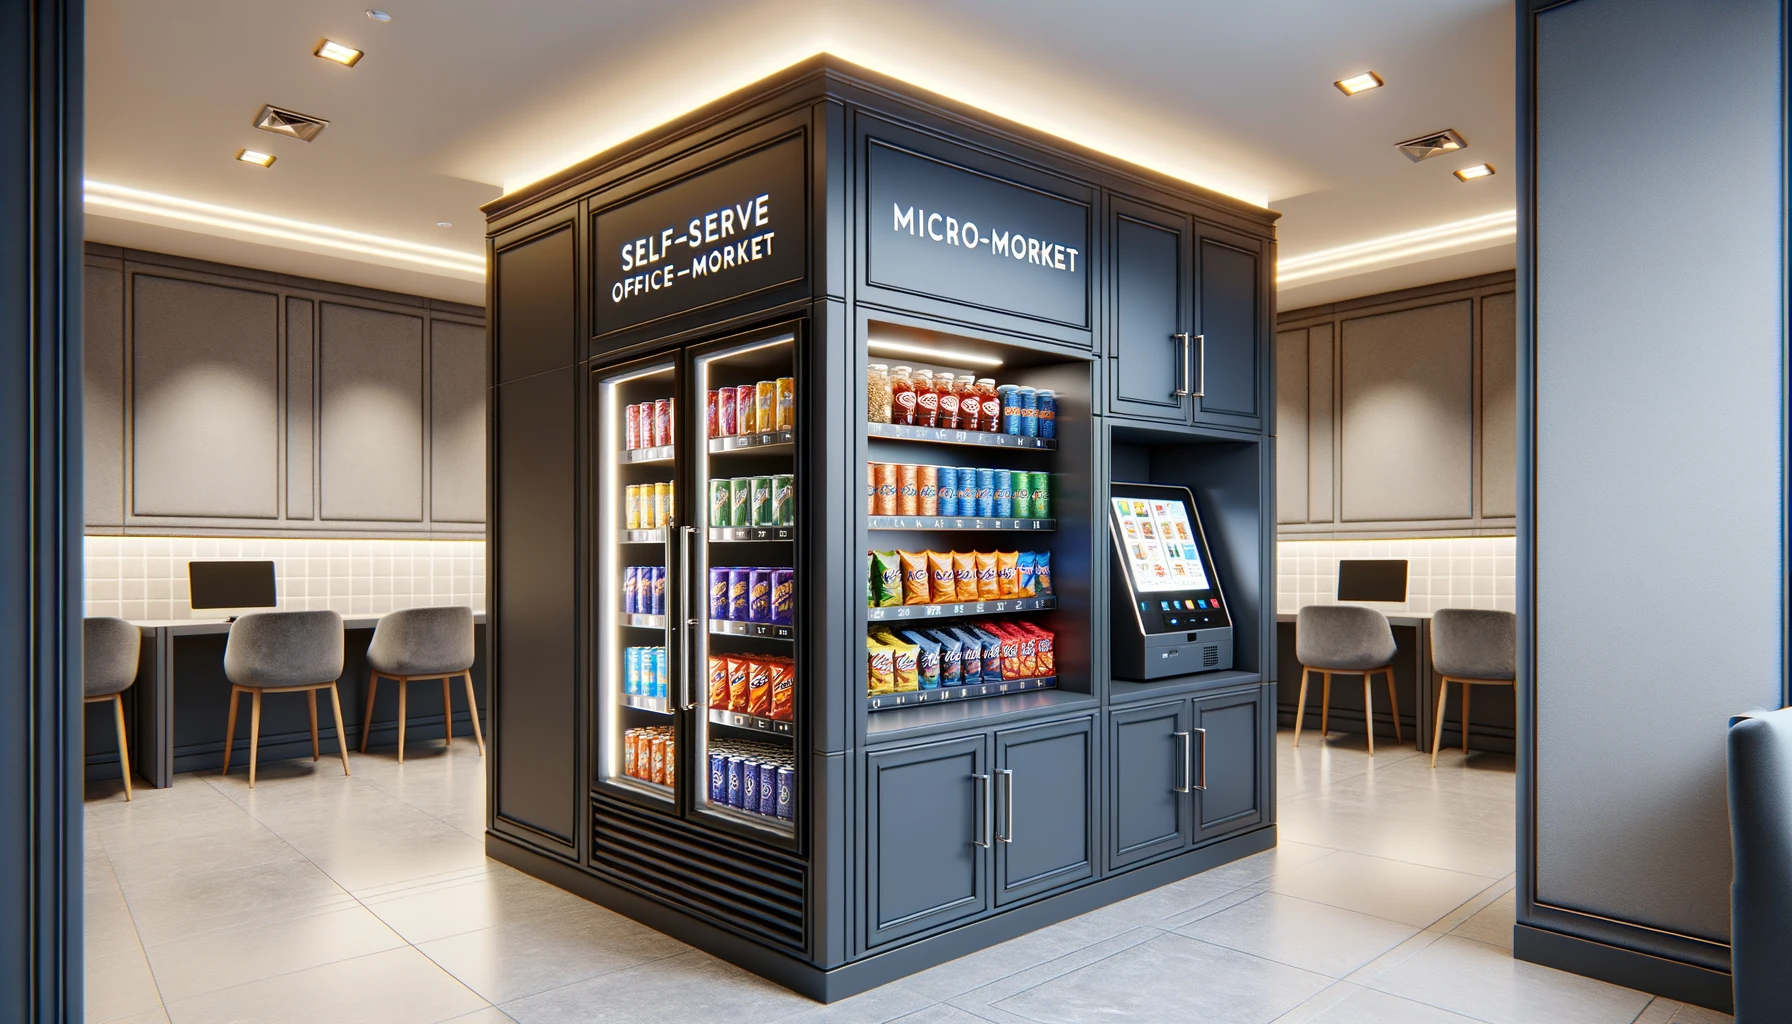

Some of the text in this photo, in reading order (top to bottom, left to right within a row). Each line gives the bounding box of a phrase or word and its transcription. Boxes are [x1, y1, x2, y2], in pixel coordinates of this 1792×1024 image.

[611, 231, 775, 304] OFFICE-MORKET
[621, 193, 770, 272] SELF-SERVE
[893, 202, 1079, 273] MICRO-MORKET
